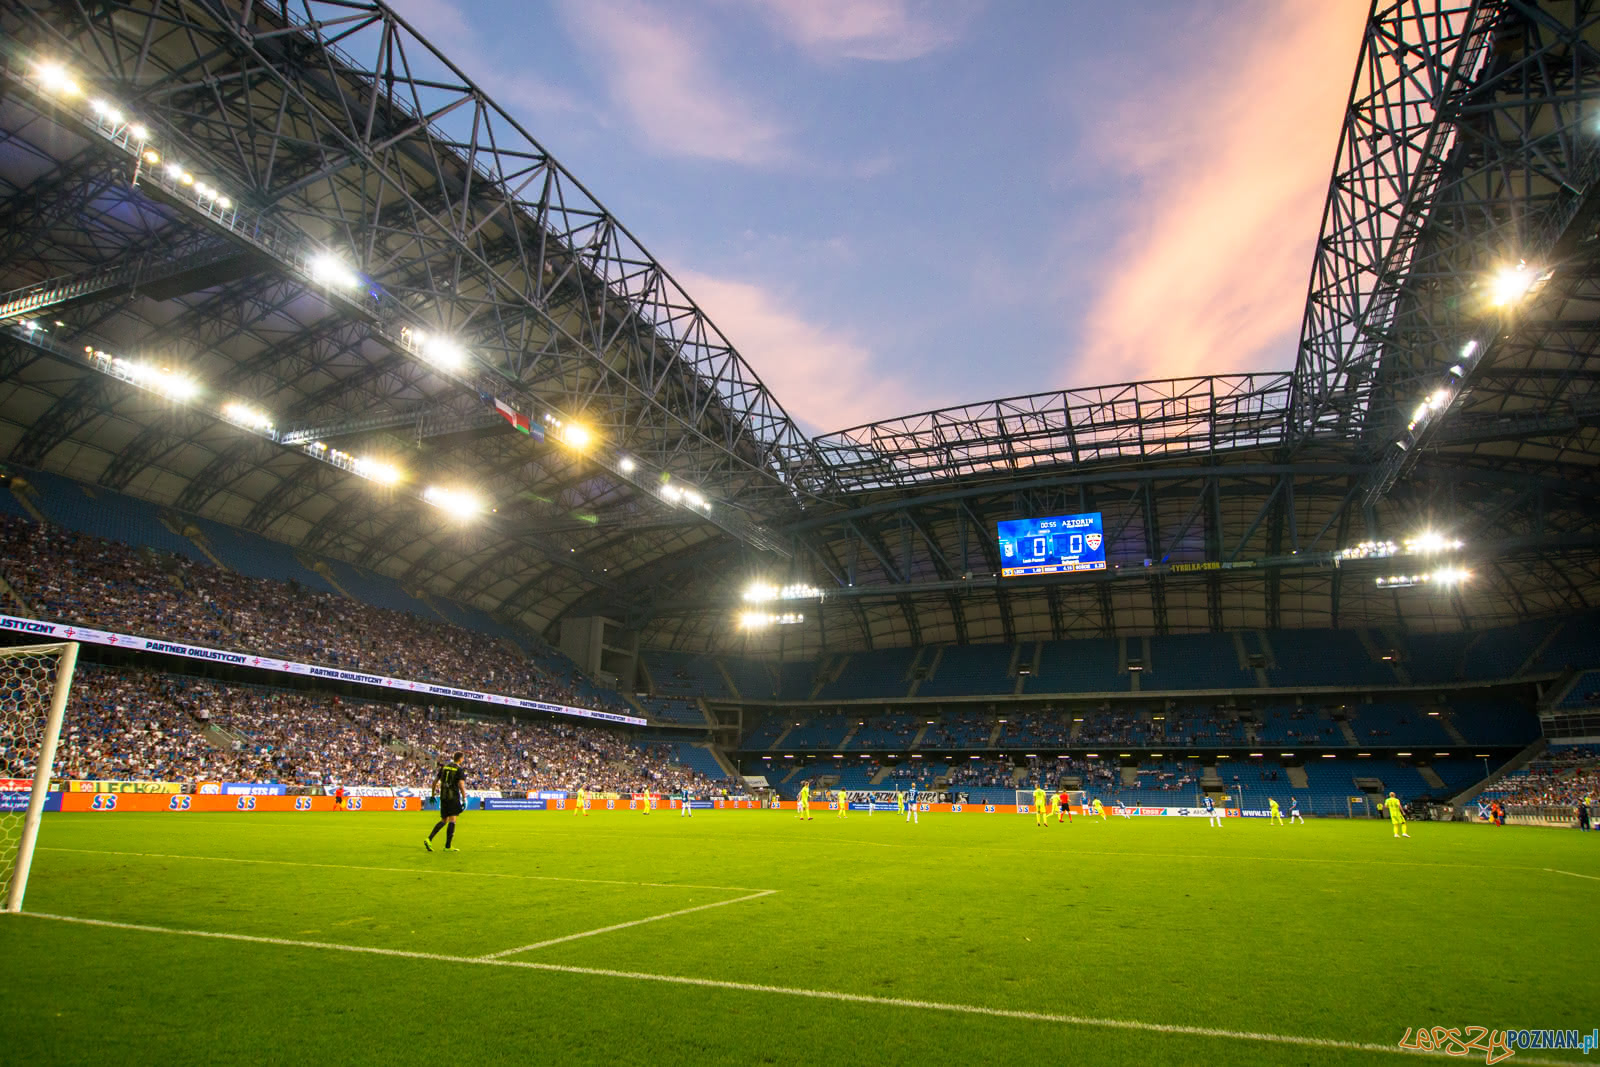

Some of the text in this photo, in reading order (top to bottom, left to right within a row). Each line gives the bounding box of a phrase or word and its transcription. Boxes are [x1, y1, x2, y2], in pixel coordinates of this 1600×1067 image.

[1034, 537, 1045, 556] 0
[1070, 534, 1082, 553] 0
[145, 641, 187, 654] PARTNER
[188, 648, 246, 663] OKULISTYCZNY
[310, 667, 383, 684] PARTNER OKULISTYCZNY
[92, 793, 118, 811] STS
[169, 795, 192, 811] STS
[237, 796, 256, 810] STS
[295, 796, 312, 810] STS
[347, 797, 362, 810] STS
[393, 798, 406, 810] STS
